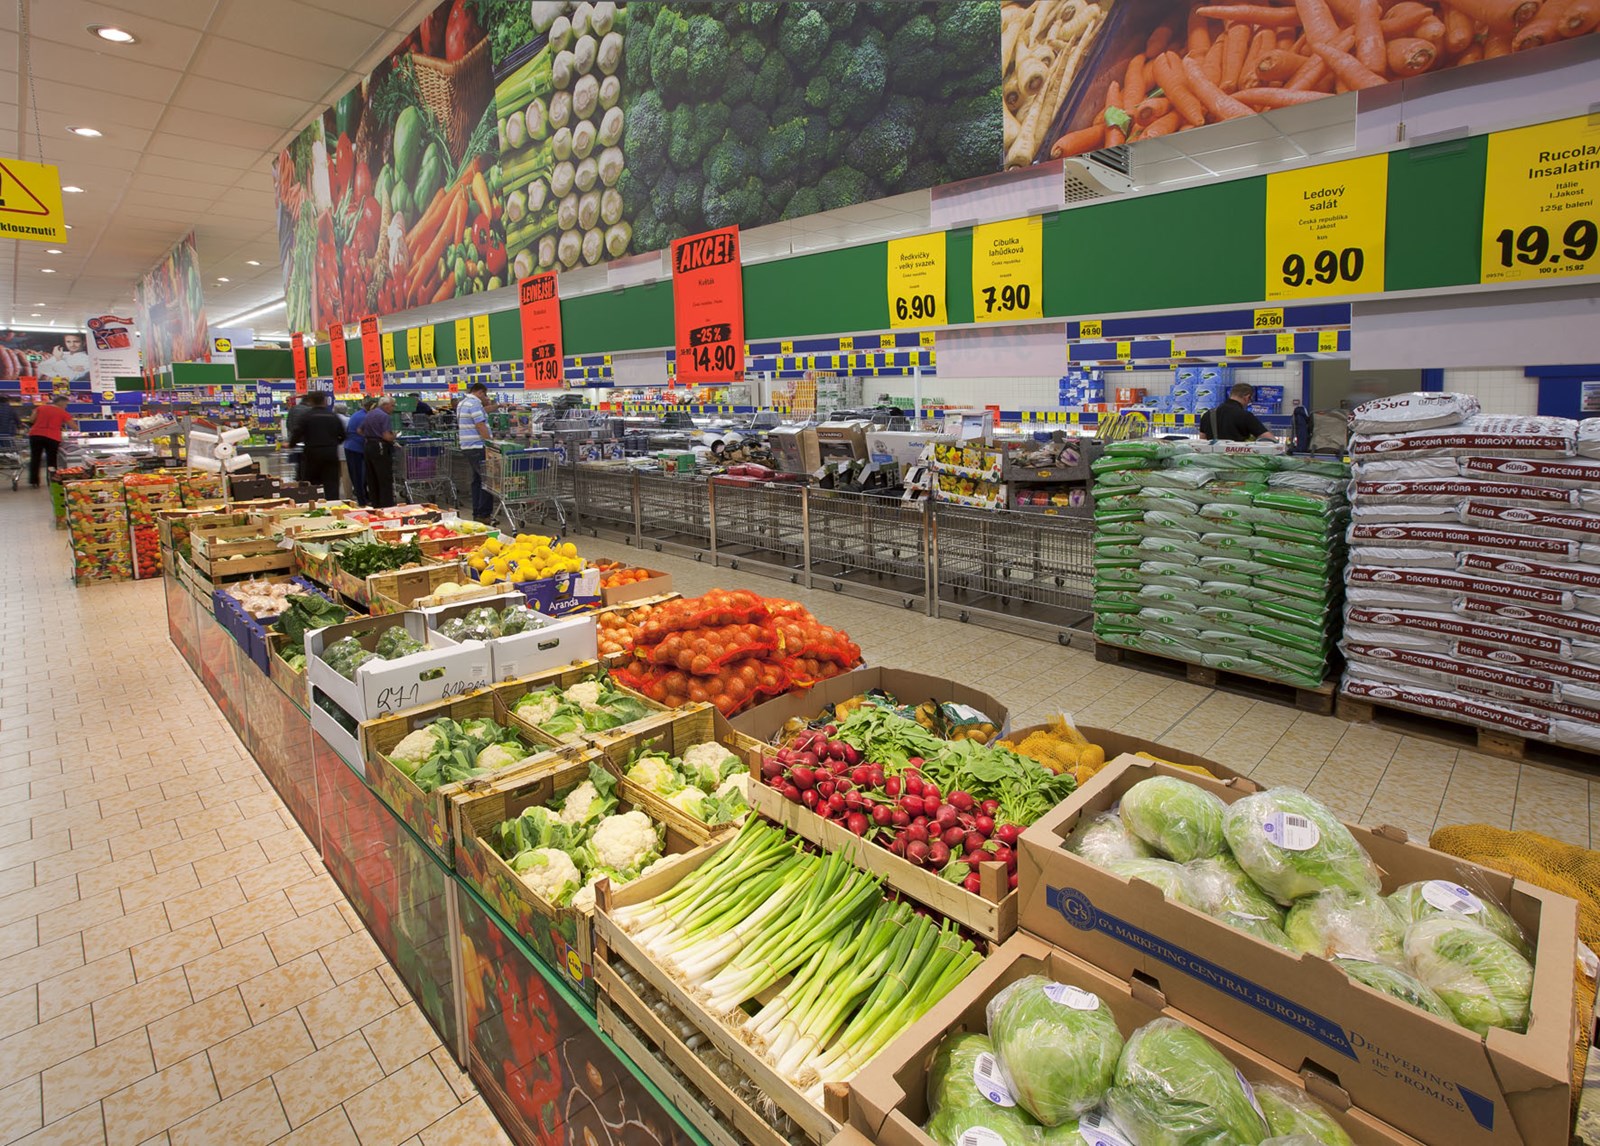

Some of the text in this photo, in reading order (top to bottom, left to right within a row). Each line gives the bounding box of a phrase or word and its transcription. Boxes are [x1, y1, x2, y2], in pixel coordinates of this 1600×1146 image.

[1556, 181, 1579, 190] Itálie
[1303, 185, 1345, 200] Ledový
[1309, 199, 1338, 211] salát
[1298, 213, 1348, 226] Česká republika
[993, 237, 1020, 248] Cibulka
[1496, 219, 1598, 267] 19.9
[679, 234, 731, 273] AKCE!
[900, 251, 930, 262] Ředkvičky
[989, 245, 1025, 257] lahůdková
[1282, 247, 1364, 287] 9.90
[982, 284, 1031, 313] 7.90
[896, 294, 936, 321] 6.90
[1255, 315, 1282, 326] 29.90
[696, 327, 712, 342] -25
[1081, 327, 1101, 336] 49.90
[692, 345, 736, 373] 14.90
[534, 360, 558, 380] 17.90
[1472, 582, 1511, 594] KŮROVÝ
[549, 598, 579, 611] Aranda
[1471, 627, 1509, 640] KŮROVÝ
[1466, 667, 1503, 680] KŮROVÝ
[1115, 926, 1187, 966] MARKETING
[1189, 961, 1252, 999] CENTRAL
[1255, 994, 1316, 1031] EUROPE
[1372, 1058, 1390, 1071] the
